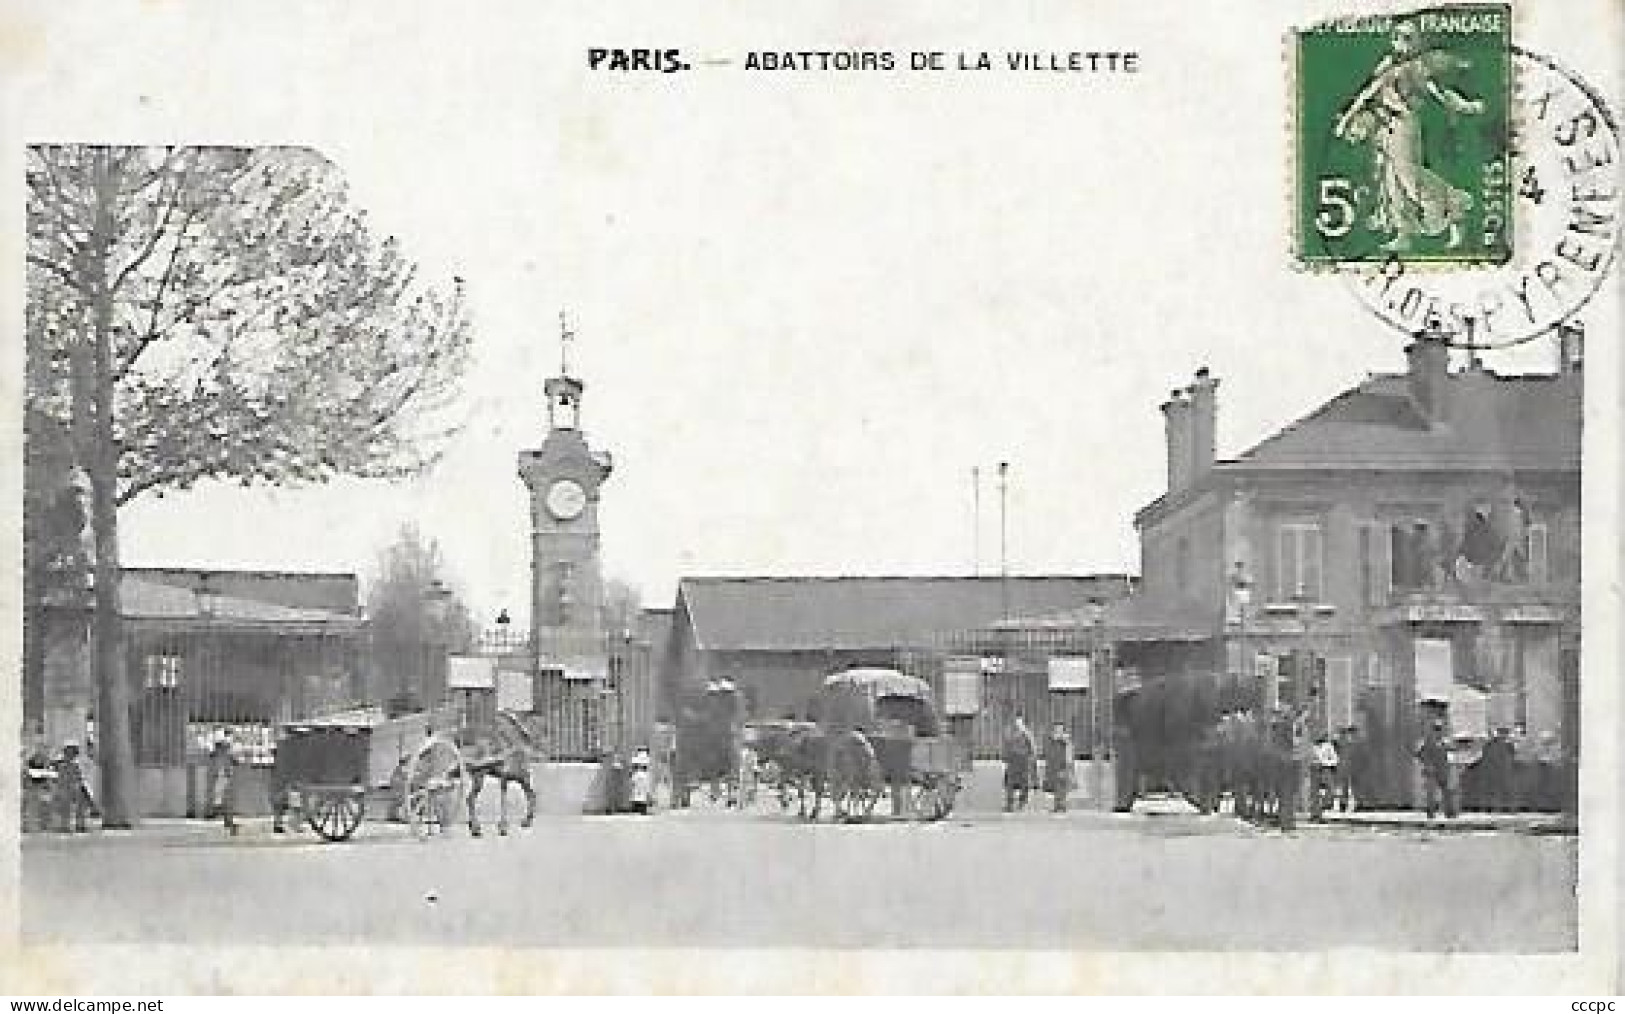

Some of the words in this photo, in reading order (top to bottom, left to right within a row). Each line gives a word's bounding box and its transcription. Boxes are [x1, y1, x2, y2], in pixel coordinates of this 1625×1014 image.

[587, 48, 691, 74] PARIS.
[744, 51, 895, 71] ABATTOIRS
[910, 51, 945, 71] DE
[957, 51, 991, 71] LA
[1006, 51, 1140, 73] VILLETTE
